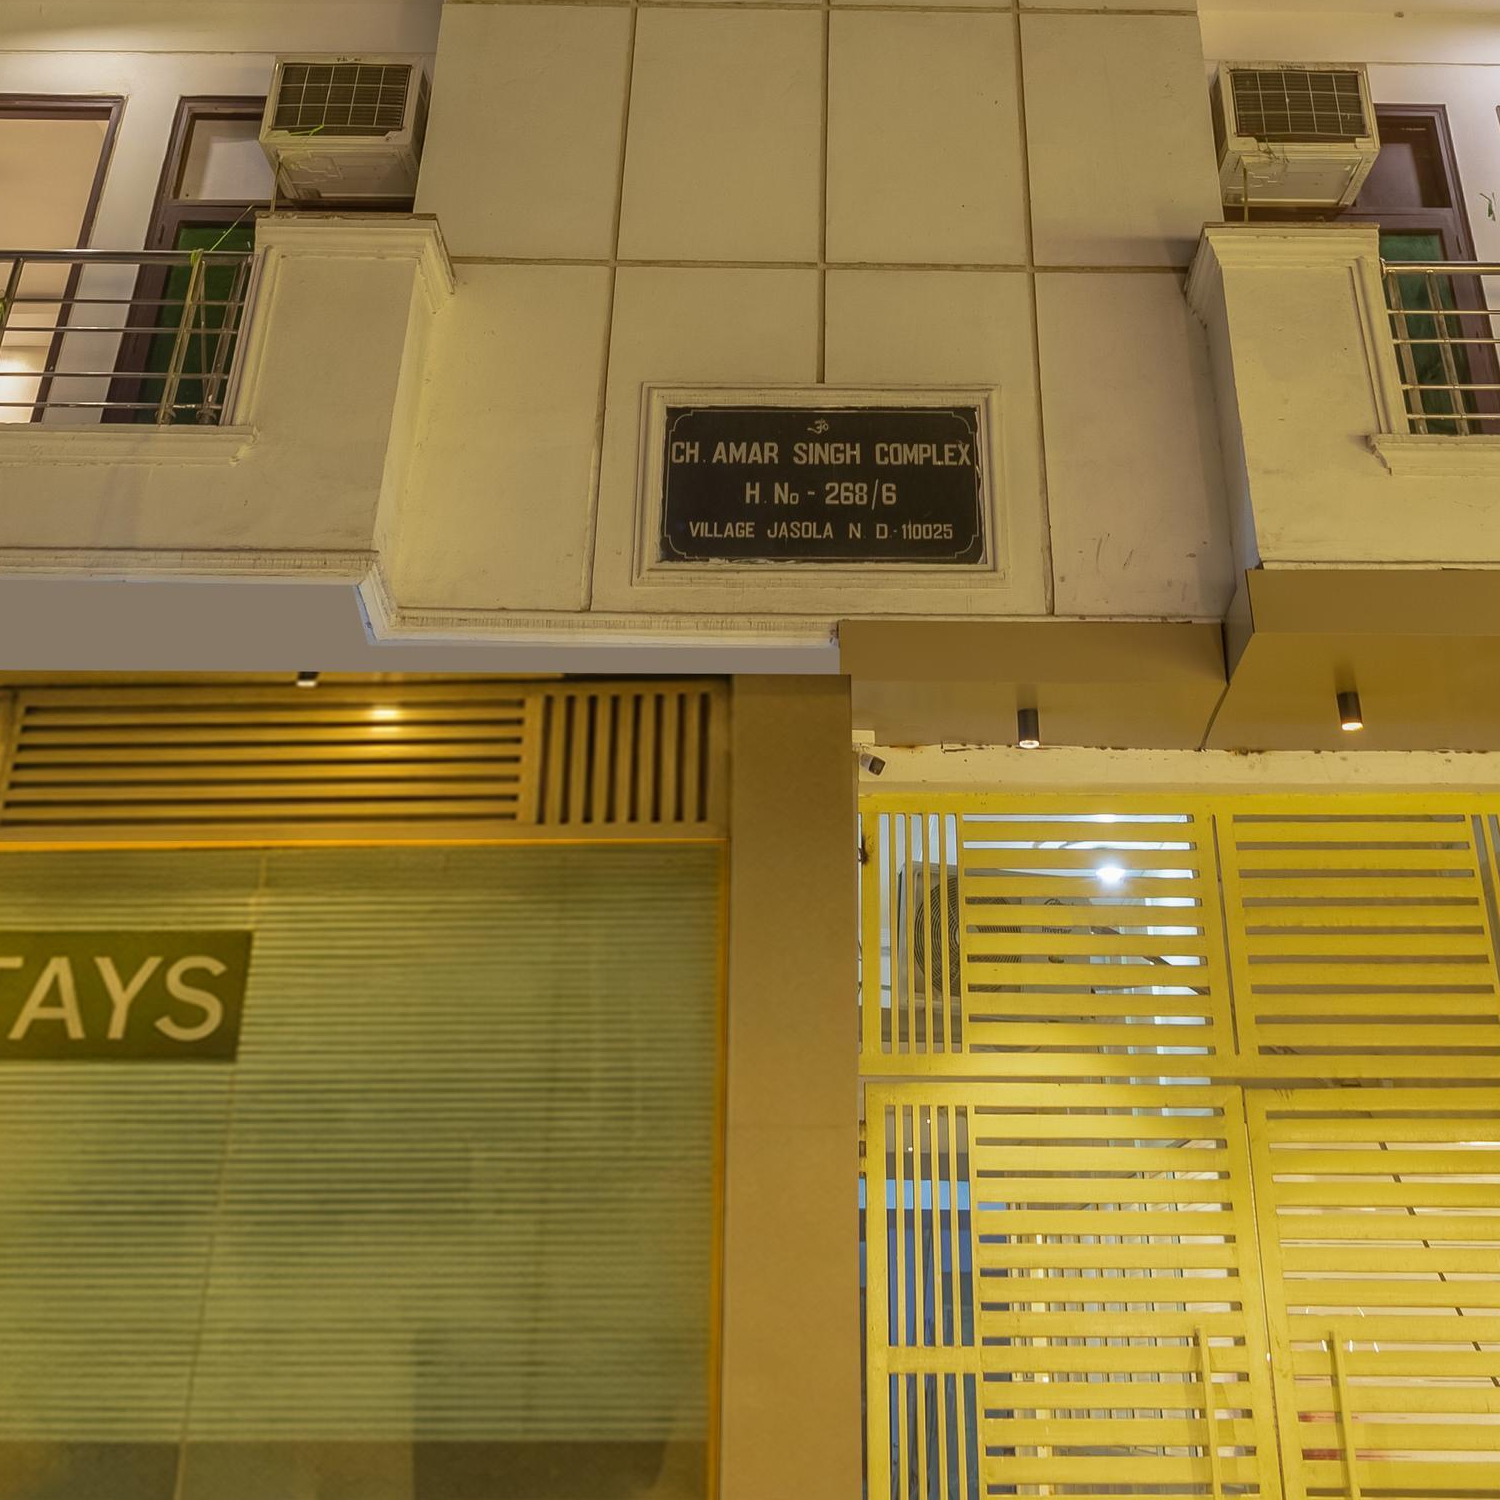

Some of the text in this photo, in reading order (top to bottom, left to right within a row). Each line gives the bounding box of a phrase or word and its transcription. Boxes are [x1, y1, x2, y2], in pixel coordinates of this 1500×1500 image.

[713, 442, 779, 465] AMAR
[793, 442, 861, 465] SINGH
[875, 442, 971, 466] COMPLEX
[825, 478, 897, 510] 268/6
[689, 521, 755, 539] VILLAGE
[767, 521, 833, 540] JASOLA
